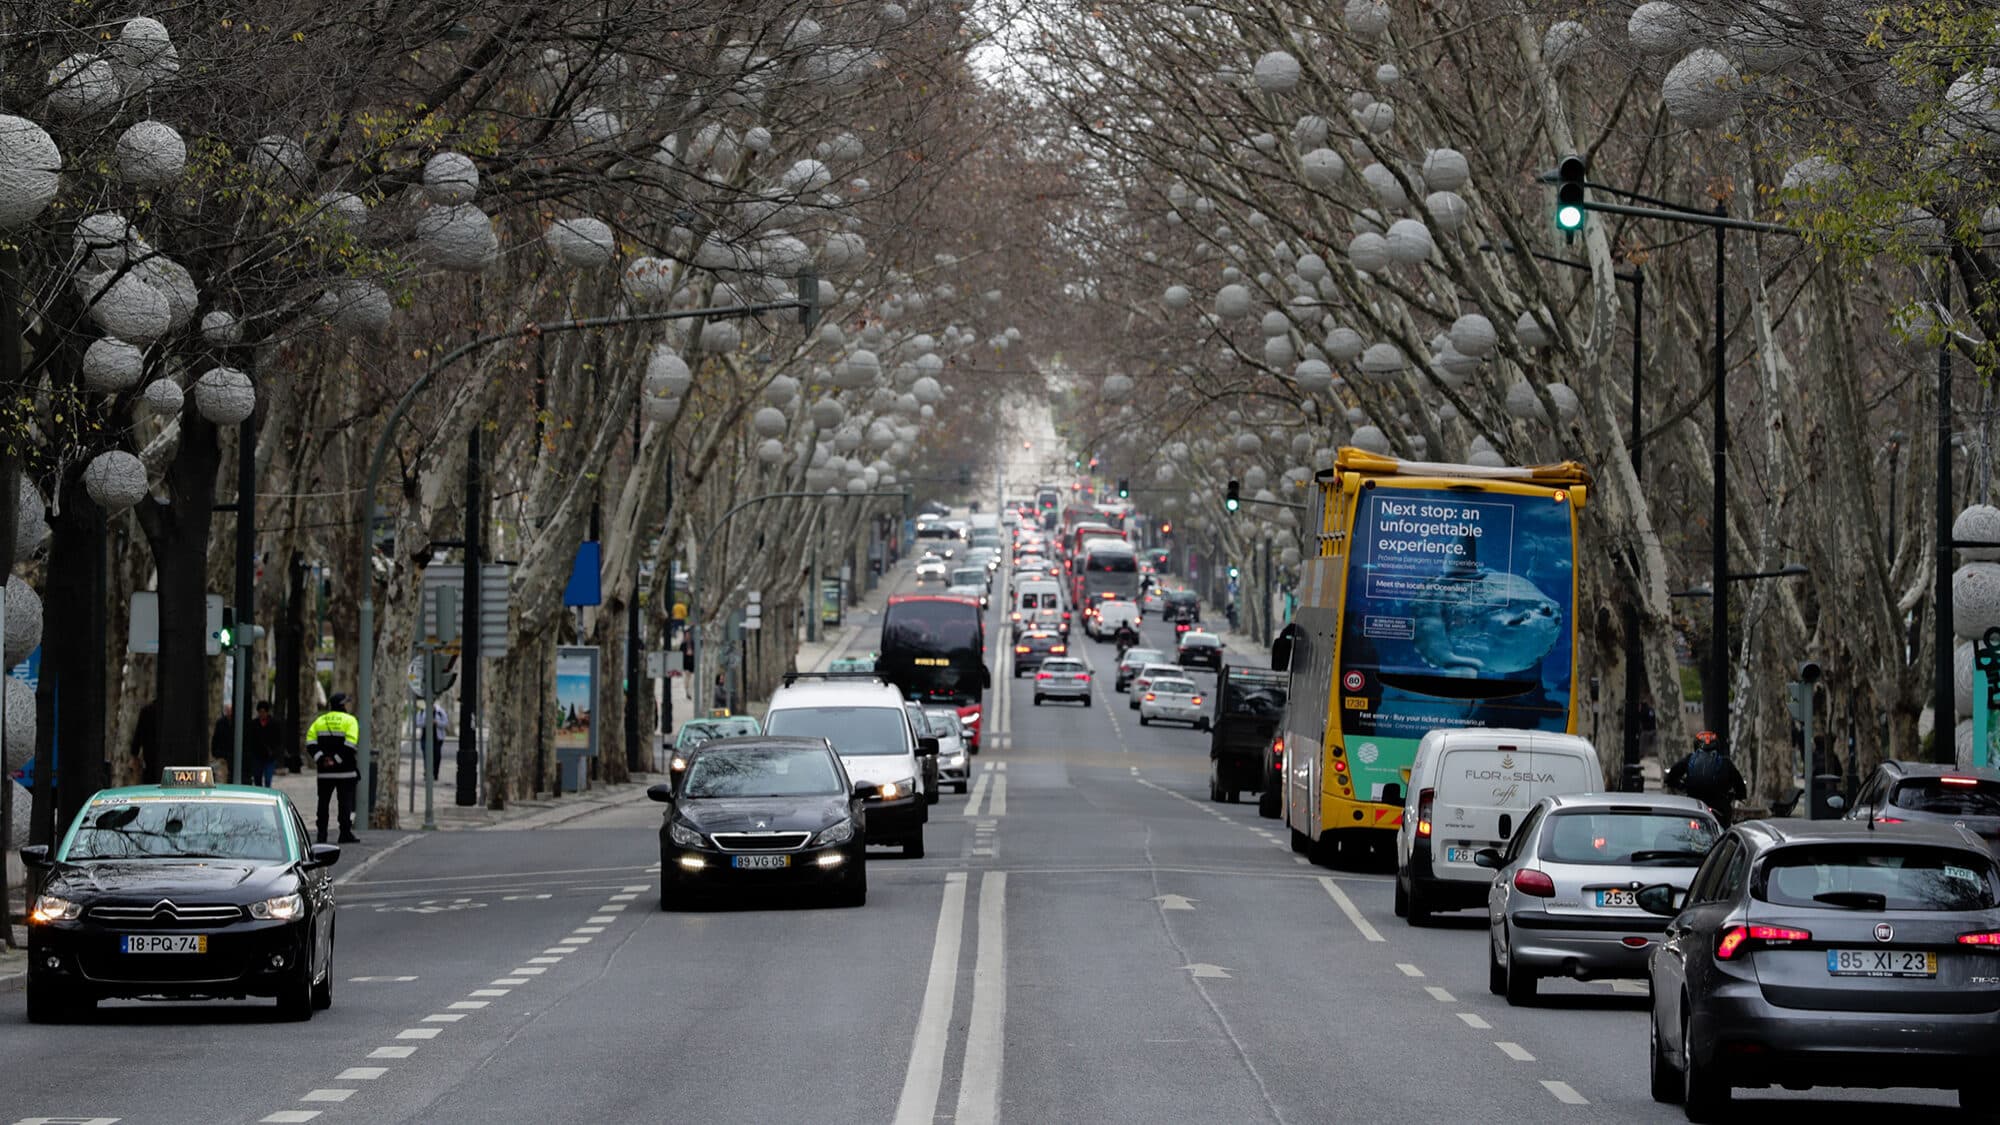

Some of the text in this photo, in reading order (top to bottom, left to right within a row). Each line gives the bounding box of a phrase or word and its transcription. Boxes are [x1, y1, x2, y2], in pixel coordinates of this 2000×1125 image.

[1381, 501, 1480, 521] Next stop: an
[1380, 519, 1483, 538] unforgettable
[1378, 538, 1467, 555] experience.
[1376, 580, 1394, 588] Meet
[1407, 582, 1425, 590] locals
[1348, 676, 1359, 685] 80
[1347, 698, 1365, 708] 1730
[1360, 711, 1371, 719] Fast
[1373, 713, 1389, 721] entry
[1393, 714, 1405, 722] Buy
[174, 771, 196, 781] TAXI
[1465, 770, 1501, 780] FLOR
[1513, 772, 1555, 783] SELVA
